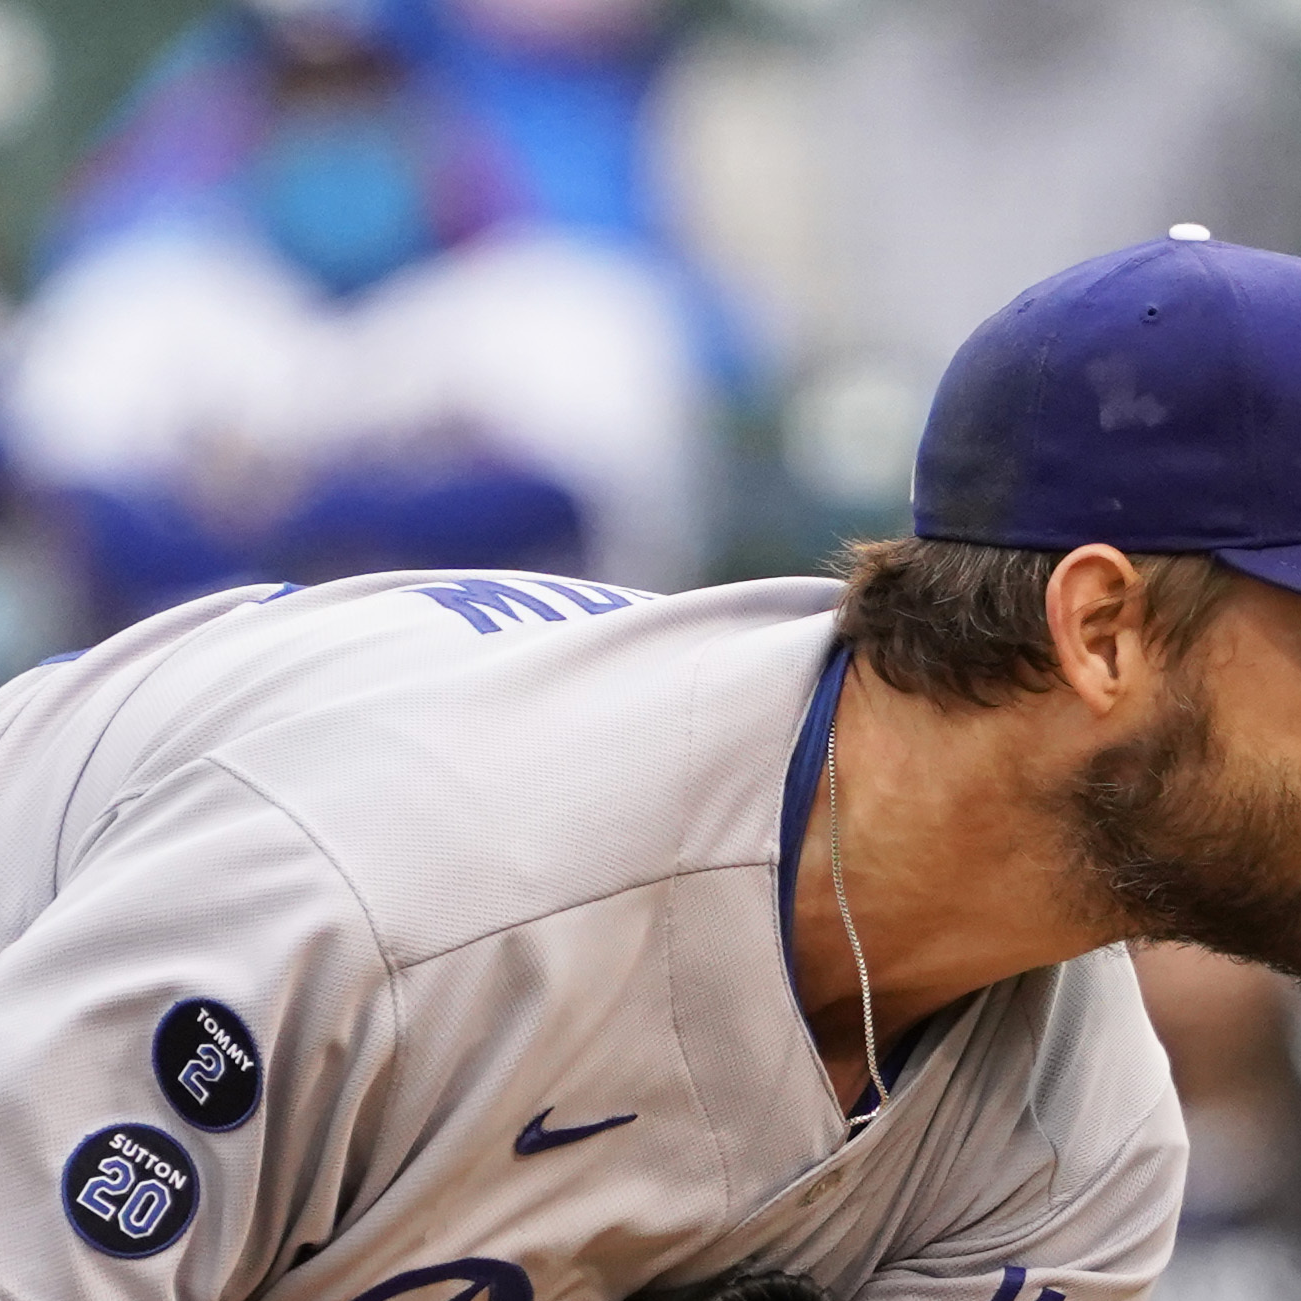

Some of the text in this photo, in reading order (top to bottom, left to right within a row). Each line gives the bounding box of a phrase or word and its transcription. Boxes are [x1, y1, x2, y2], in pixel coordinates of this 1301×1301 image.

[196, 1007, 255, 1073] TOMMY
[177, 1043, 226, 1106] 2
[108, 1133, 188, 1191] SUTTON
[76, 1156, 172, 1239] 20
